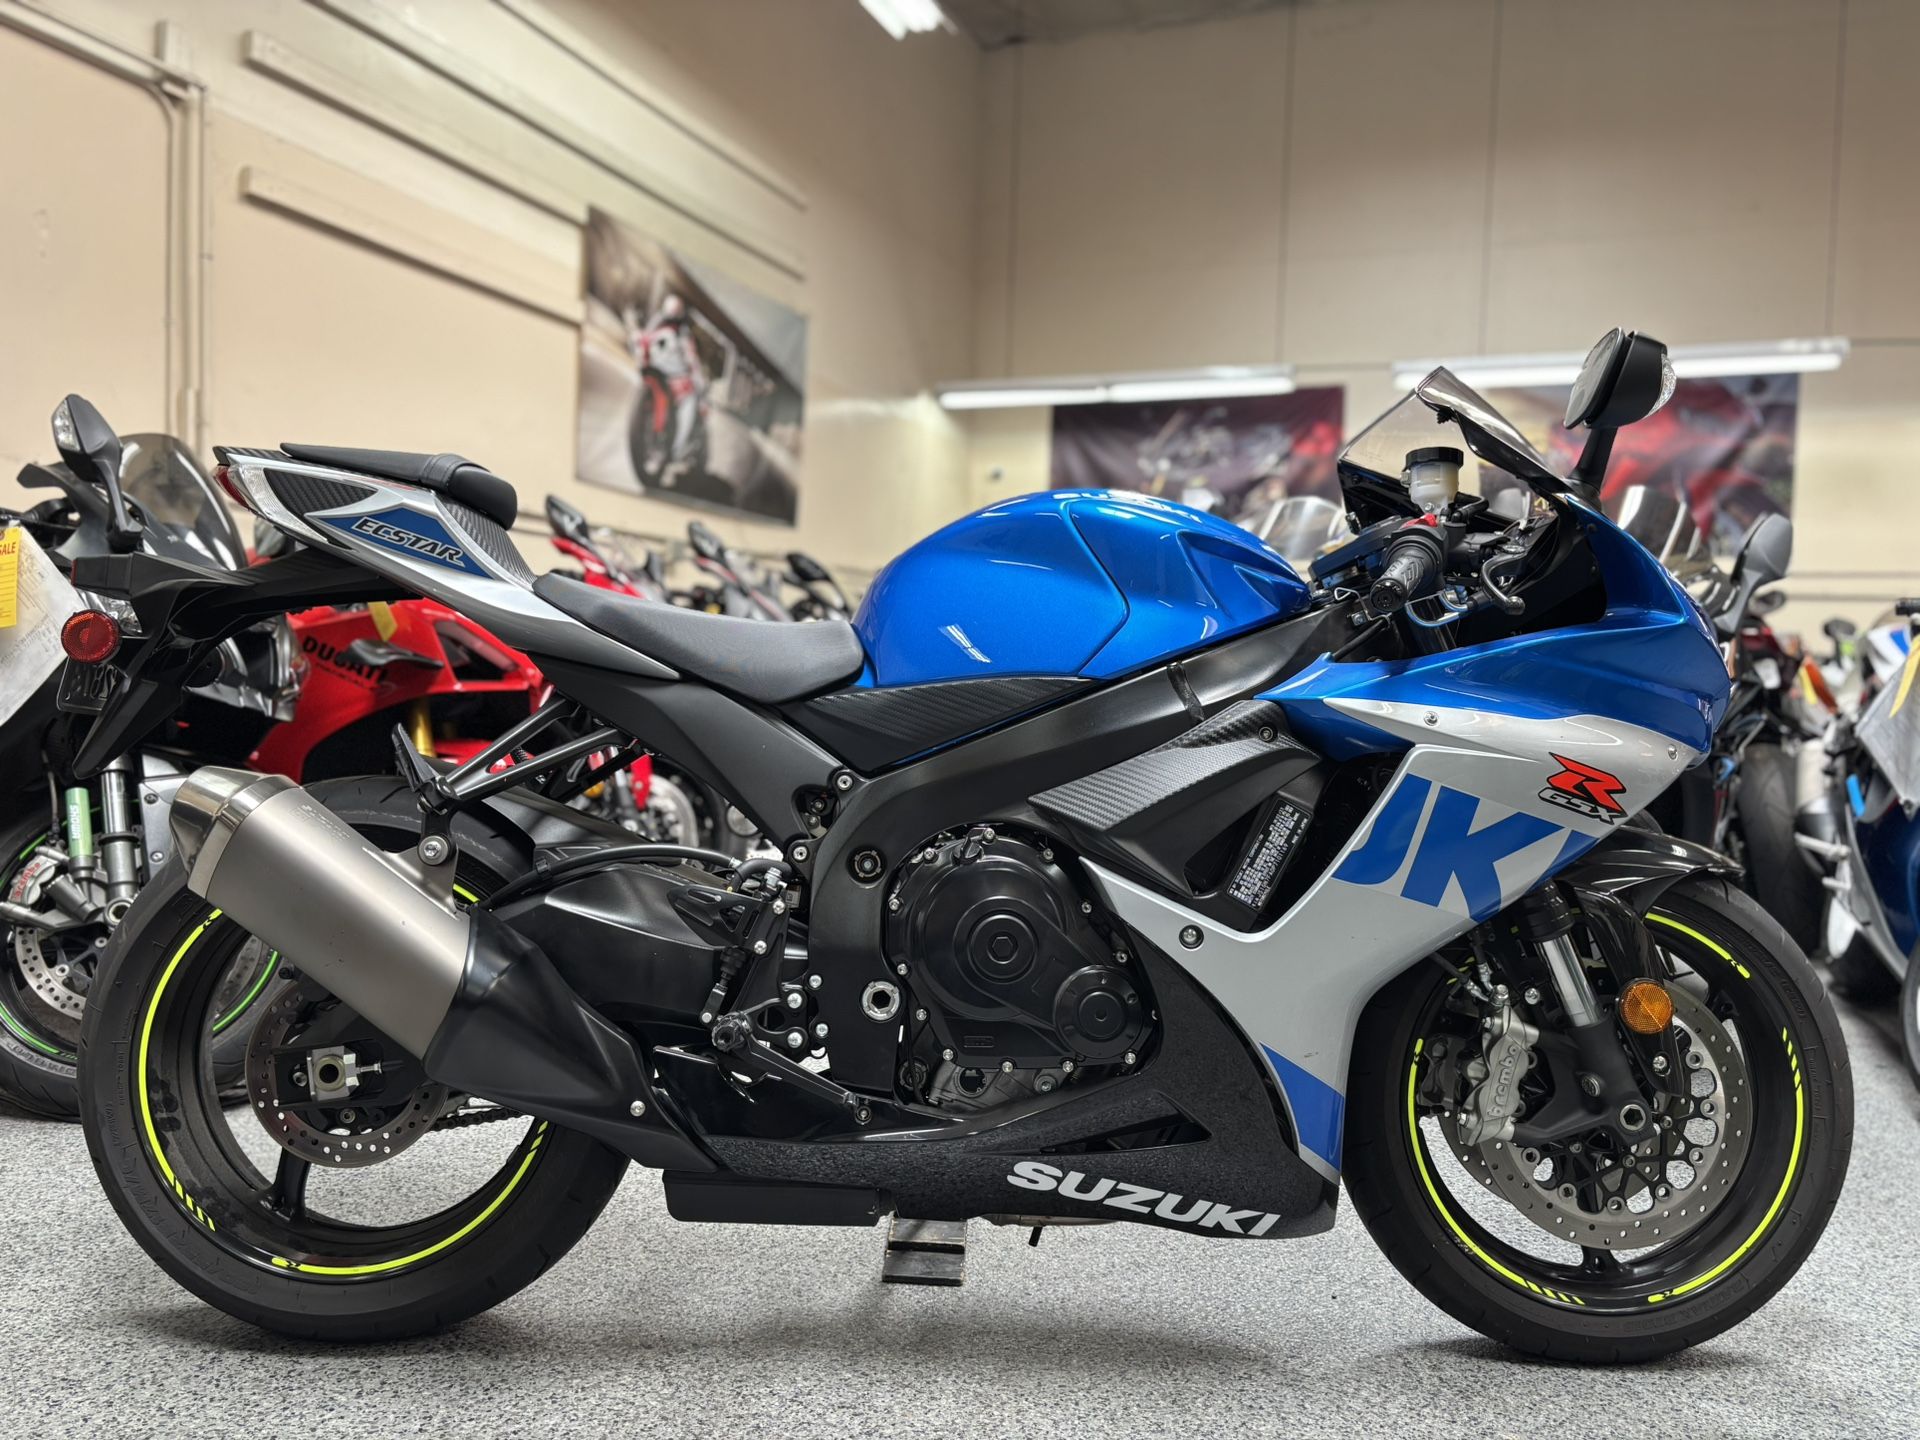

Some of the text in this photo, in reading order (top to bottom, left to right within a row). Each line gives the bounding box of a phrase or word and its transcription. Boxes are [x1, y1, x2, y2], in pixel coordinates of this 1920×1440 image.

[351, 516, 466, 568] ECSTAR
[1538, 787, 1628, 826] GSX
[1487, 1045, 1520, 1117] brembo
[1007, 1161, 1281, 1237] SUZUKI
